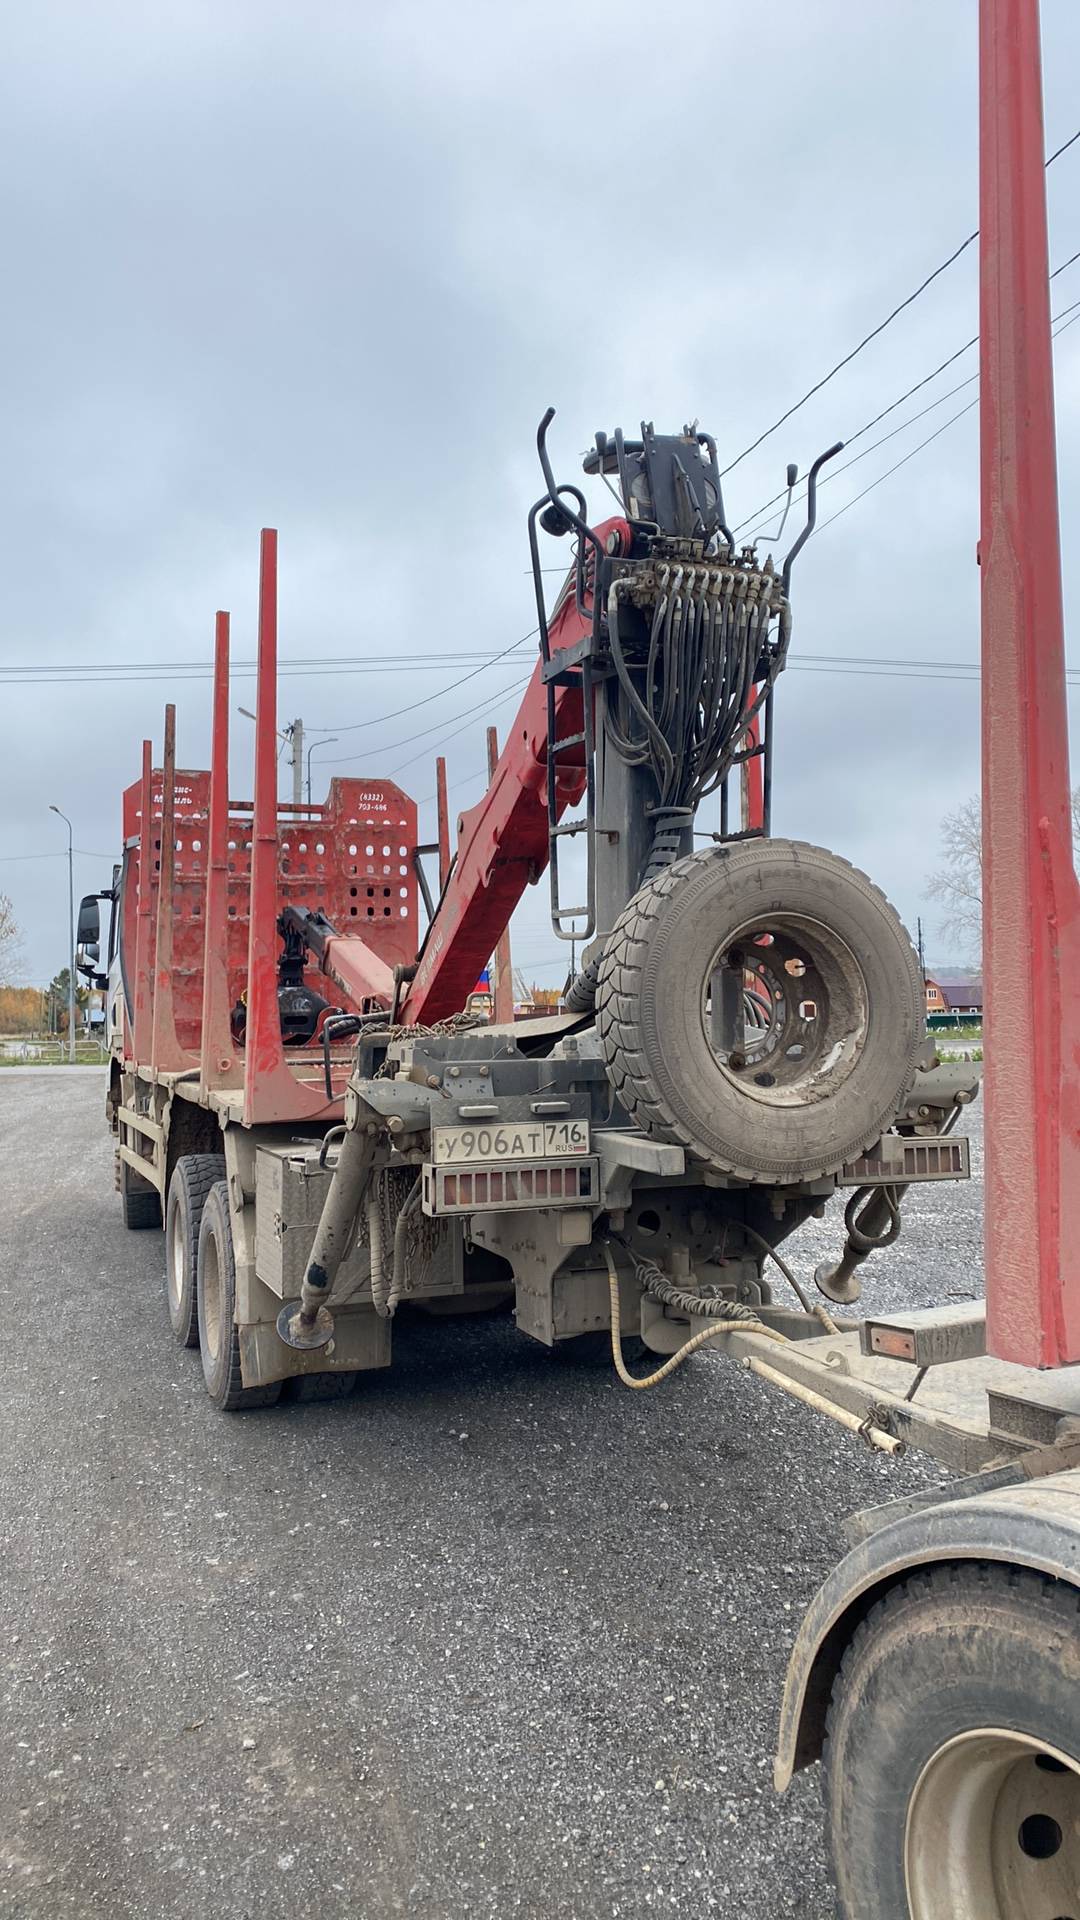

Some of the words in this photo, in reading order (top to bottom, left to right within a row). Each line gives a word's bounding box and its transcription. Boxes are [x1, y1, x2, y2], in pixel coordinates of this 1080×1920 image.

[153, 794, 193, 804] Миль
[359, 792, 384, 803] (8332)
[445, 1130, 541, 1158] У906АТ
[546, 1124, 582, 1145] 716
[556, 1144, 573, 1152] RUS
